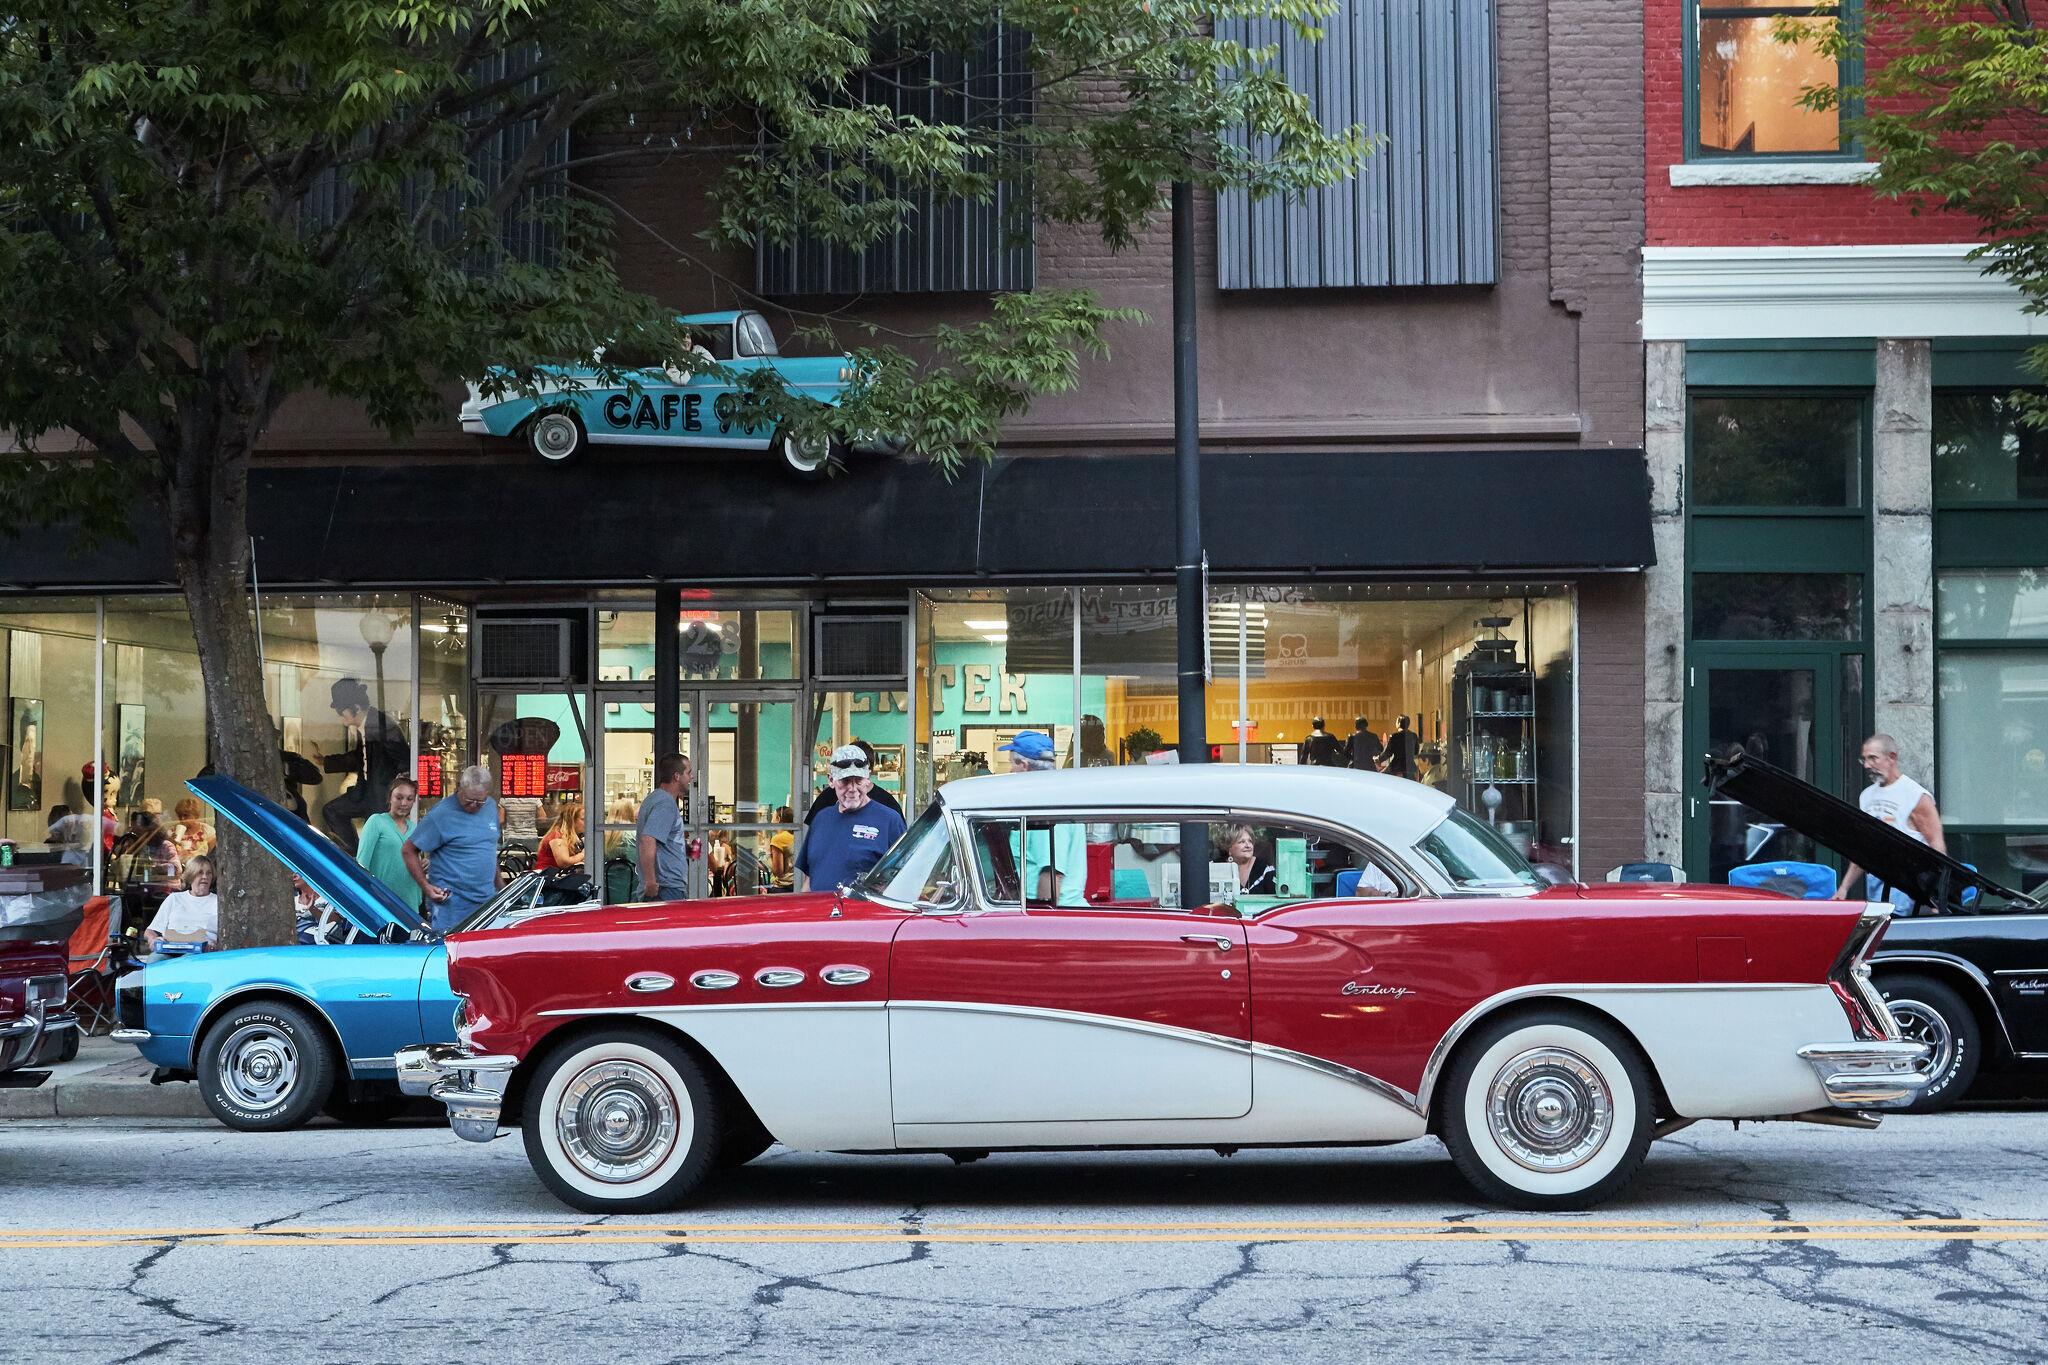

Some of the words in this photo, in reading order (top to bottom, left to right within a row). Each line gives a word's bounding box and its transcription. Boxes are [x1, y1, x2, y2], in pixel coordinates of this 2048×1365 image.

[604, 394, 702, 432] CAFE
[497, 726, 549, 747] OPEN
[1341, 981, 1416, 999] Century
[234, 1014, 276, 1026] Radial
[279, 1019, 294, 1035] T/A
[1948, 1038, 1964, 1079] EAGLE
[215, 1093, 288, 1119] BFGoodrich
